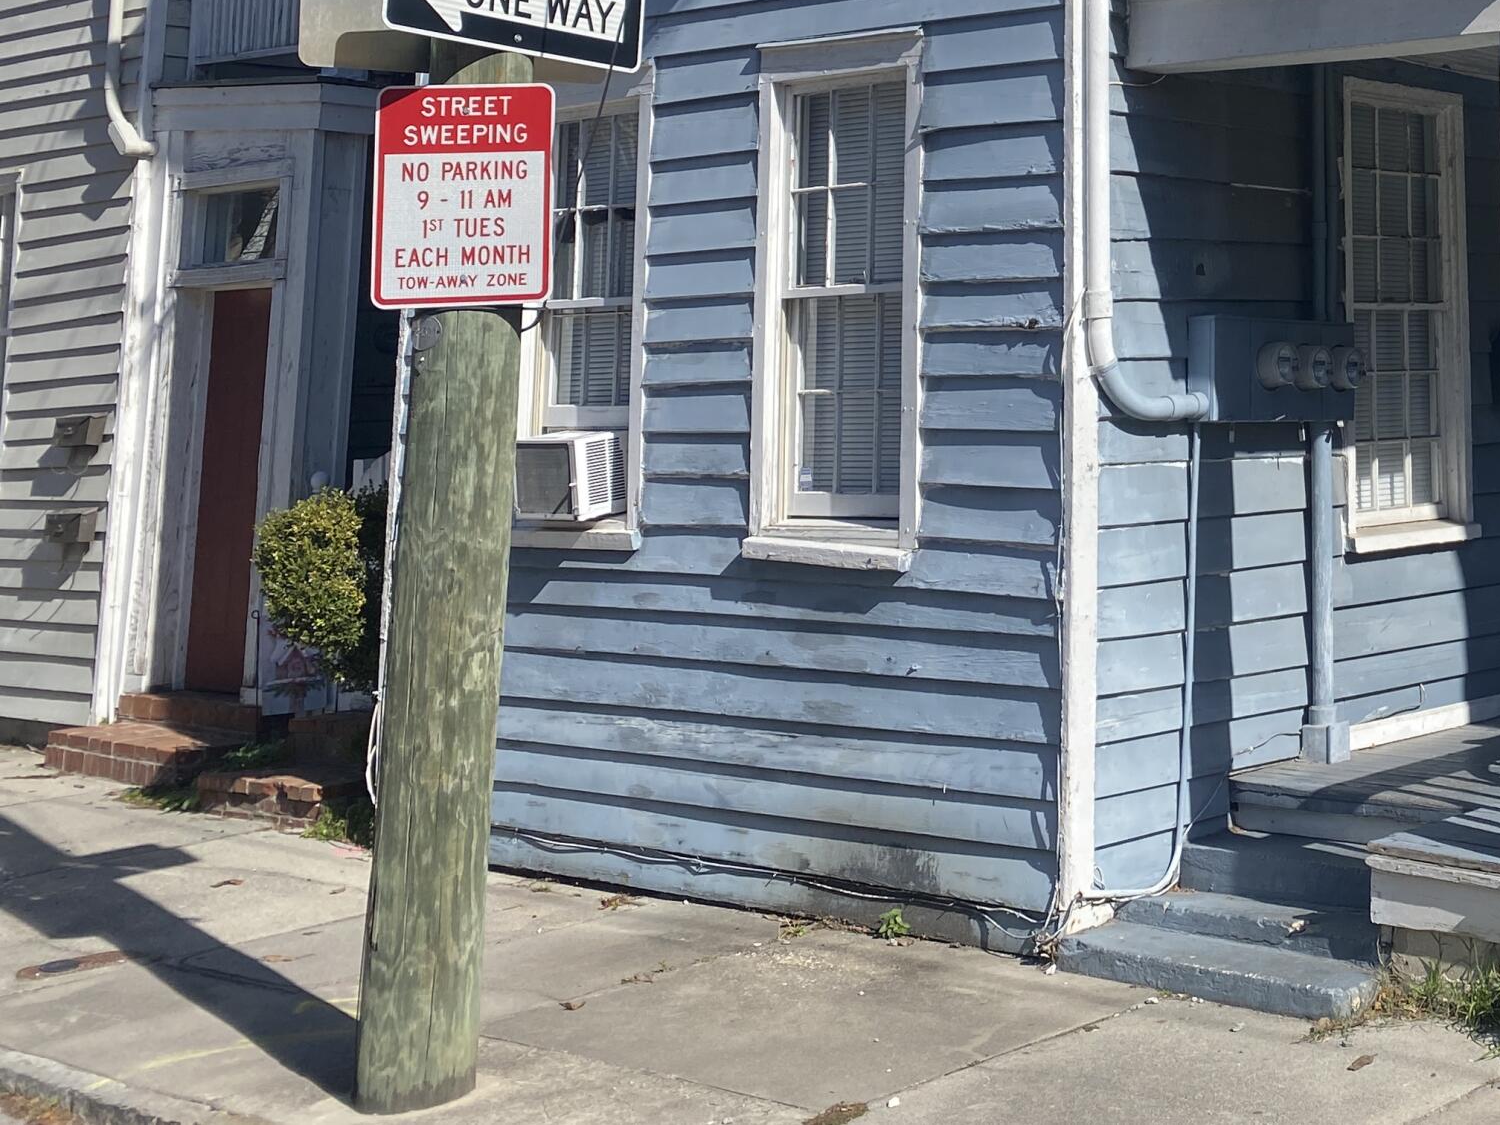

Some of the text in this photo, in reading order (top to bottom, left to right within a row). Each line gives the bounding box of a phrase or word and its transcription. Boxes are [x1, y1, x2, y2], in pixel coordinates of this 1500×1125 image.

[421, 96, 512, 117] STREET
[403, 123, 528, 146] SWEEPING
[402, 160, 528, 182] NO PARKING
[417, 191, 429, 210] 9
[460, 190, 473, 209] 11
[483, 189, 512, 208] AM
[422, 217, 505, 238] 1ST TUES
[395, 244, 530, 268] EACH MONTH
[398, 273, 527, 290] TOW-AWAY ZONE
